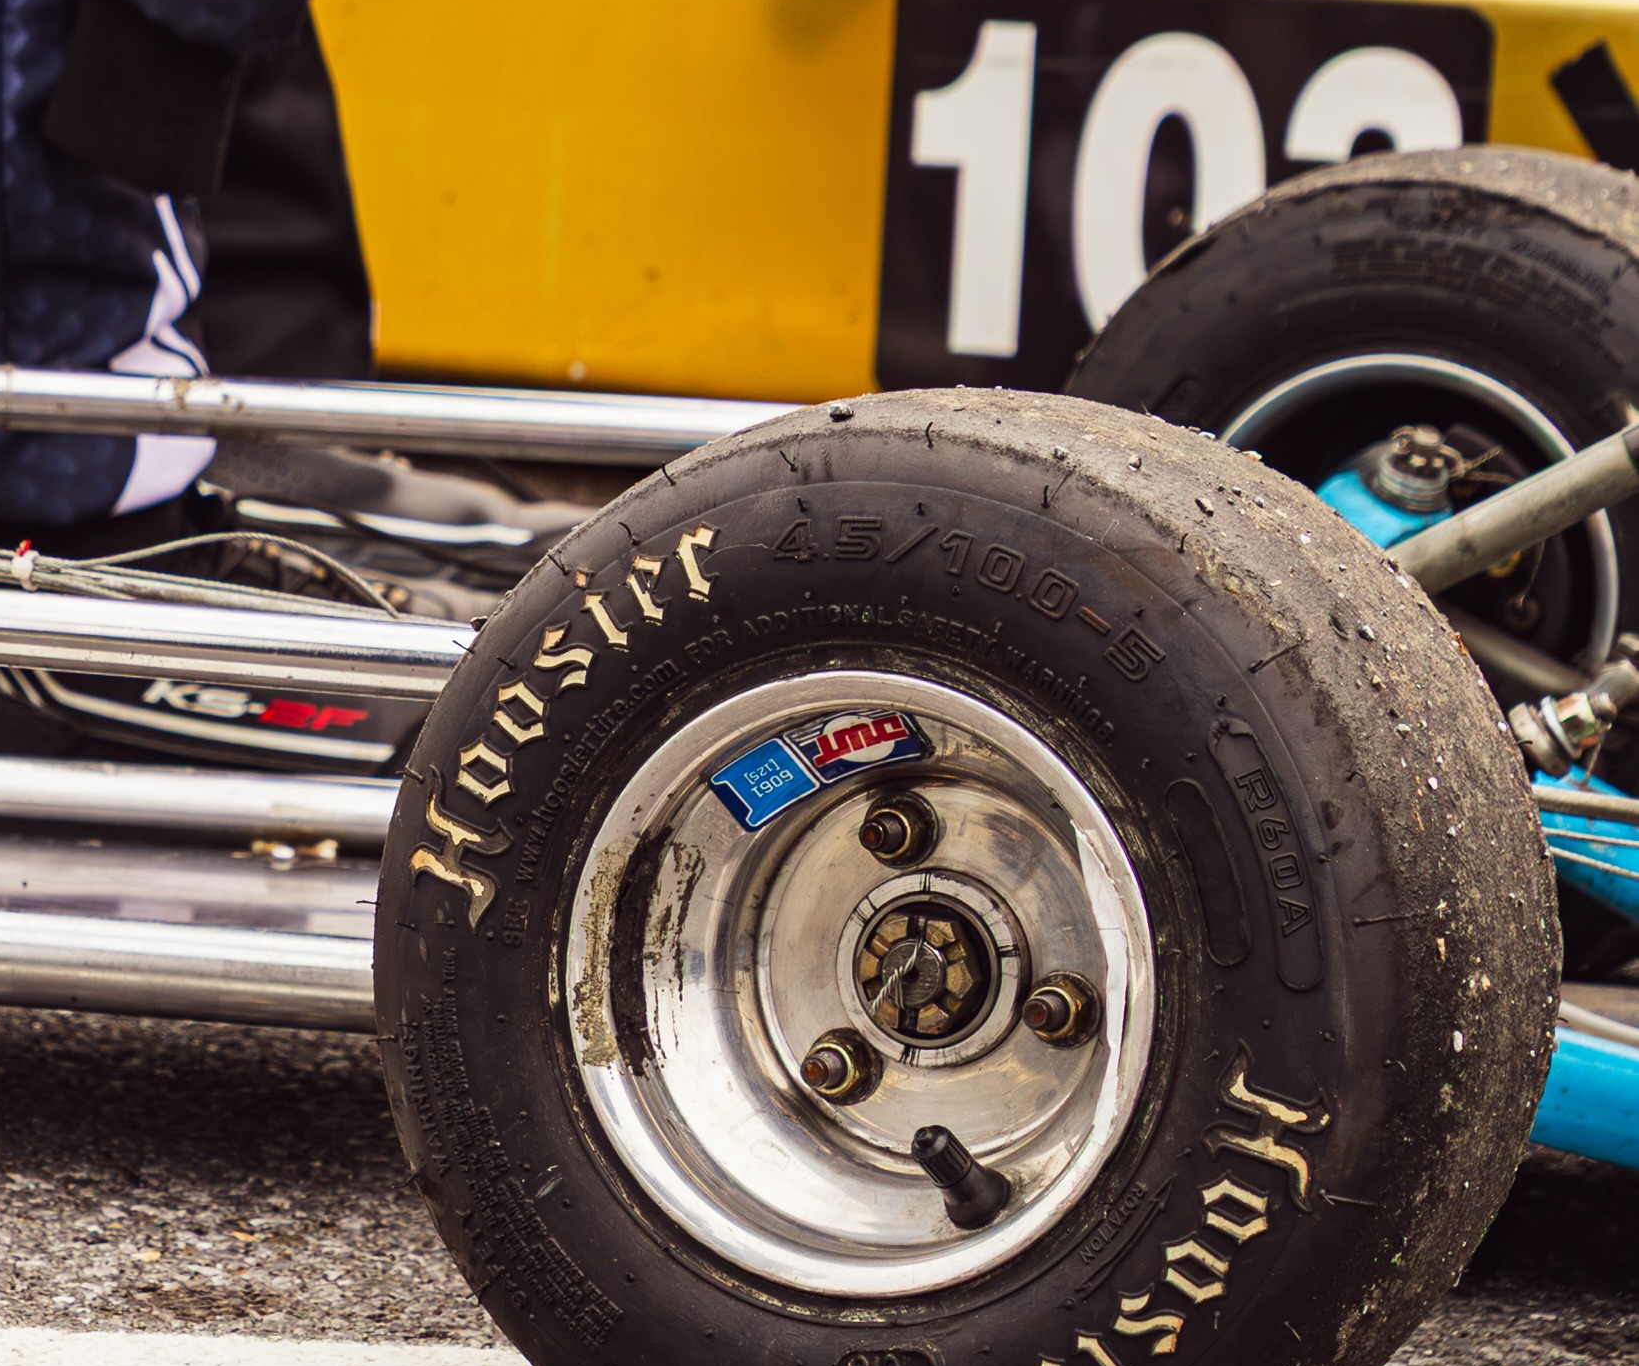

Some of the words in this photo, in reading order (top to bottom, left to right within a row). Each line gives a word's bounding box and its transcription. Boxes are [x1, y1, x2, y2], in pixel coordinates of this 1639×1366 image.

[414, 522, 719, 926] Hoosier
[813, 715, 909, 767] DWT
[751, 769, 794, 798] 6061
[1232, 765, 1314, 937] R60A
